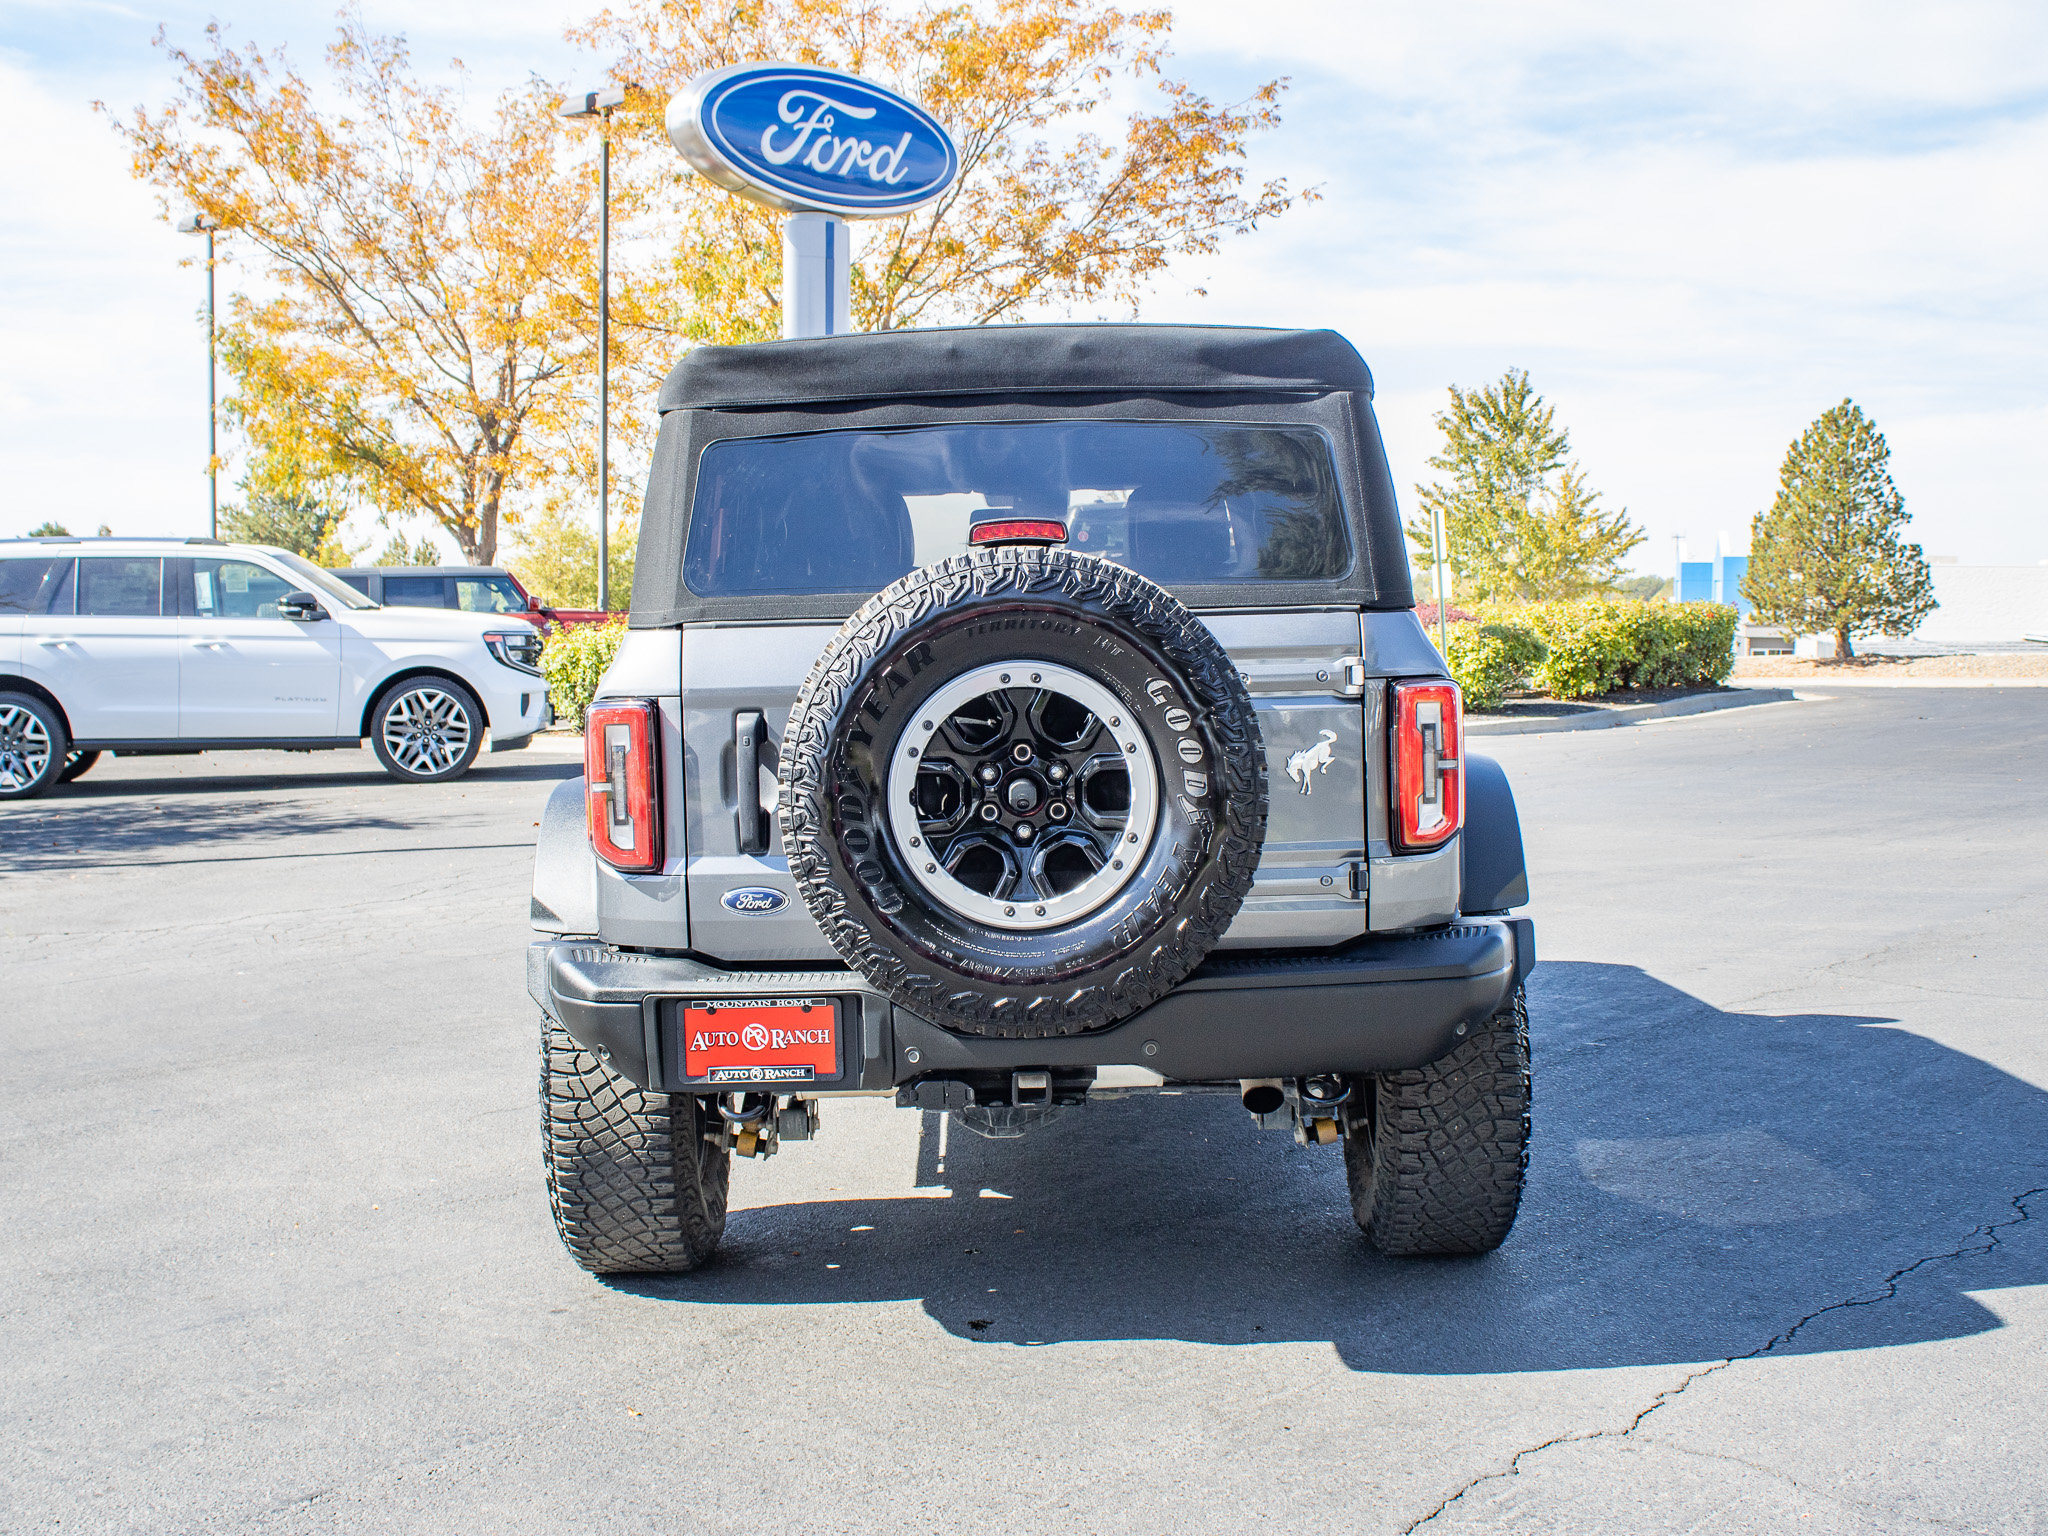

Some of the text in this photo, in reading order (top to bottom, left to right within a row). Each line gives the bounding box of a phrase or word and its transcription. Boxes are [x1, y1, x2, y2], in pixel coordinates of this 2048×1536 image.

[760, 89, 912, 185] Ford
[736, 894, 773, 909] Ford
[706, 998, 812, 1008] MOUNTAIN HOME
